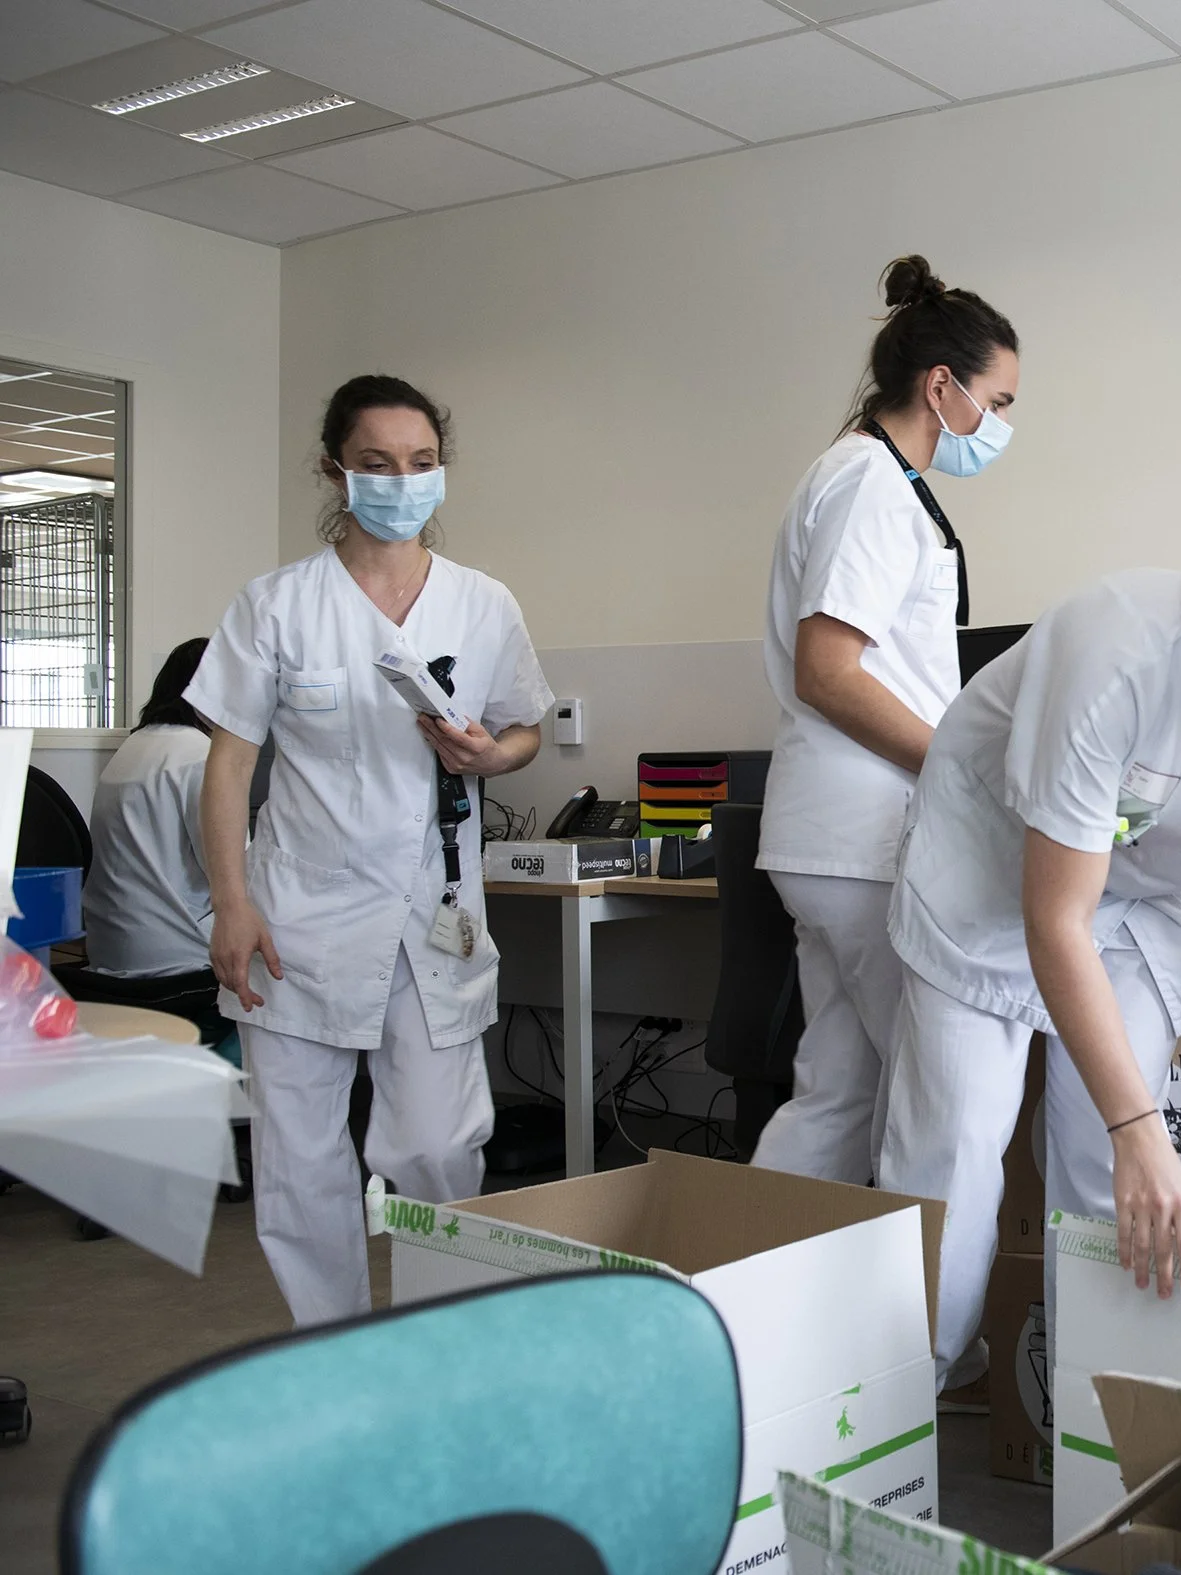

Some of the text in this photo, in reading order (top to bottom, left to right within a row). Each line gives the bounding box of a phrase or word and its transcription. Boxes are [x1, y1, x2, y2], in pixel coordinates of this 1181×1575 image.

[512, 857, 544, 875] tecno
[489, 1228, 509, 1245] l'art
[512, 1233, 525, 1247] de
[527, 1237, 569, 1260] hommes
